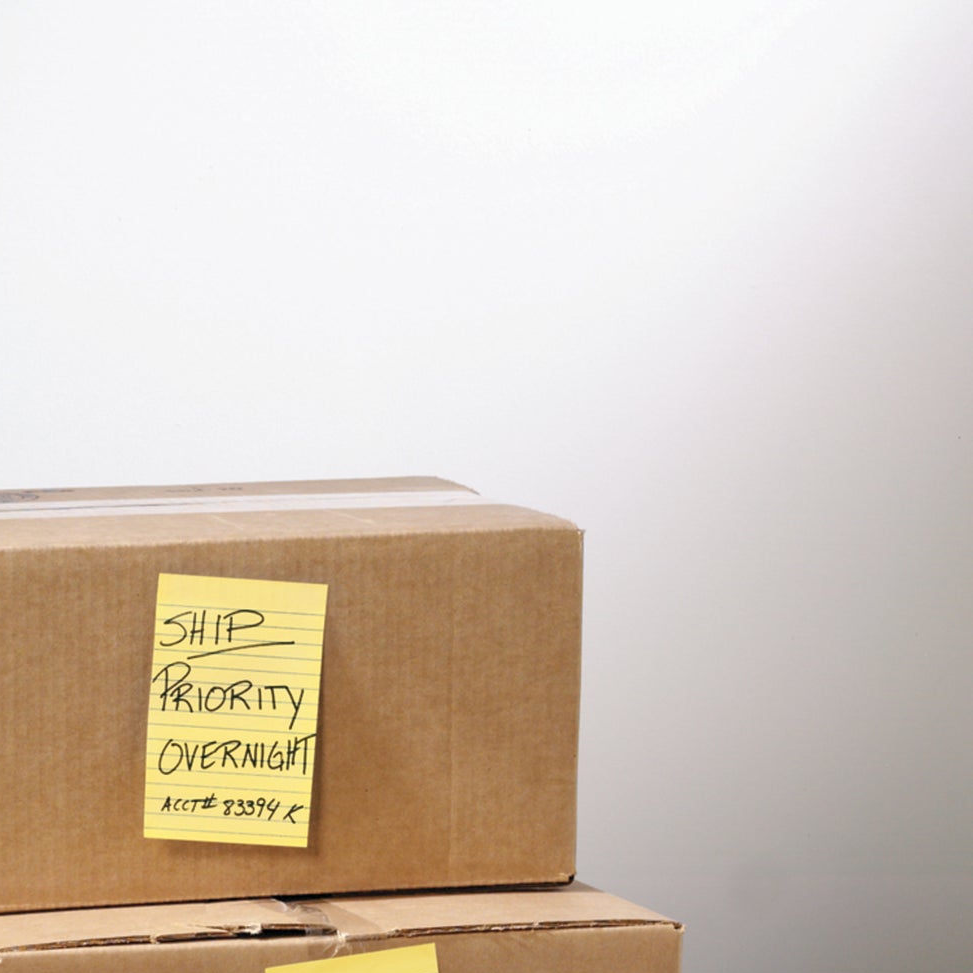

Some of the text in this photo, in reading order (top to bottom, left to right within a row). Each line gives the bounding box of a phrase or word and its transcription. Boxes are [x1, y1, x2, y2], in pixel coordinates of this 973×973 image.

[159, 609, 265, 647] SHIP
[152, 661, 305, 730] PRIORITY
[158, 733, 317, 776] OVERNIGHT
[222, 797, 281, 821] 83394
